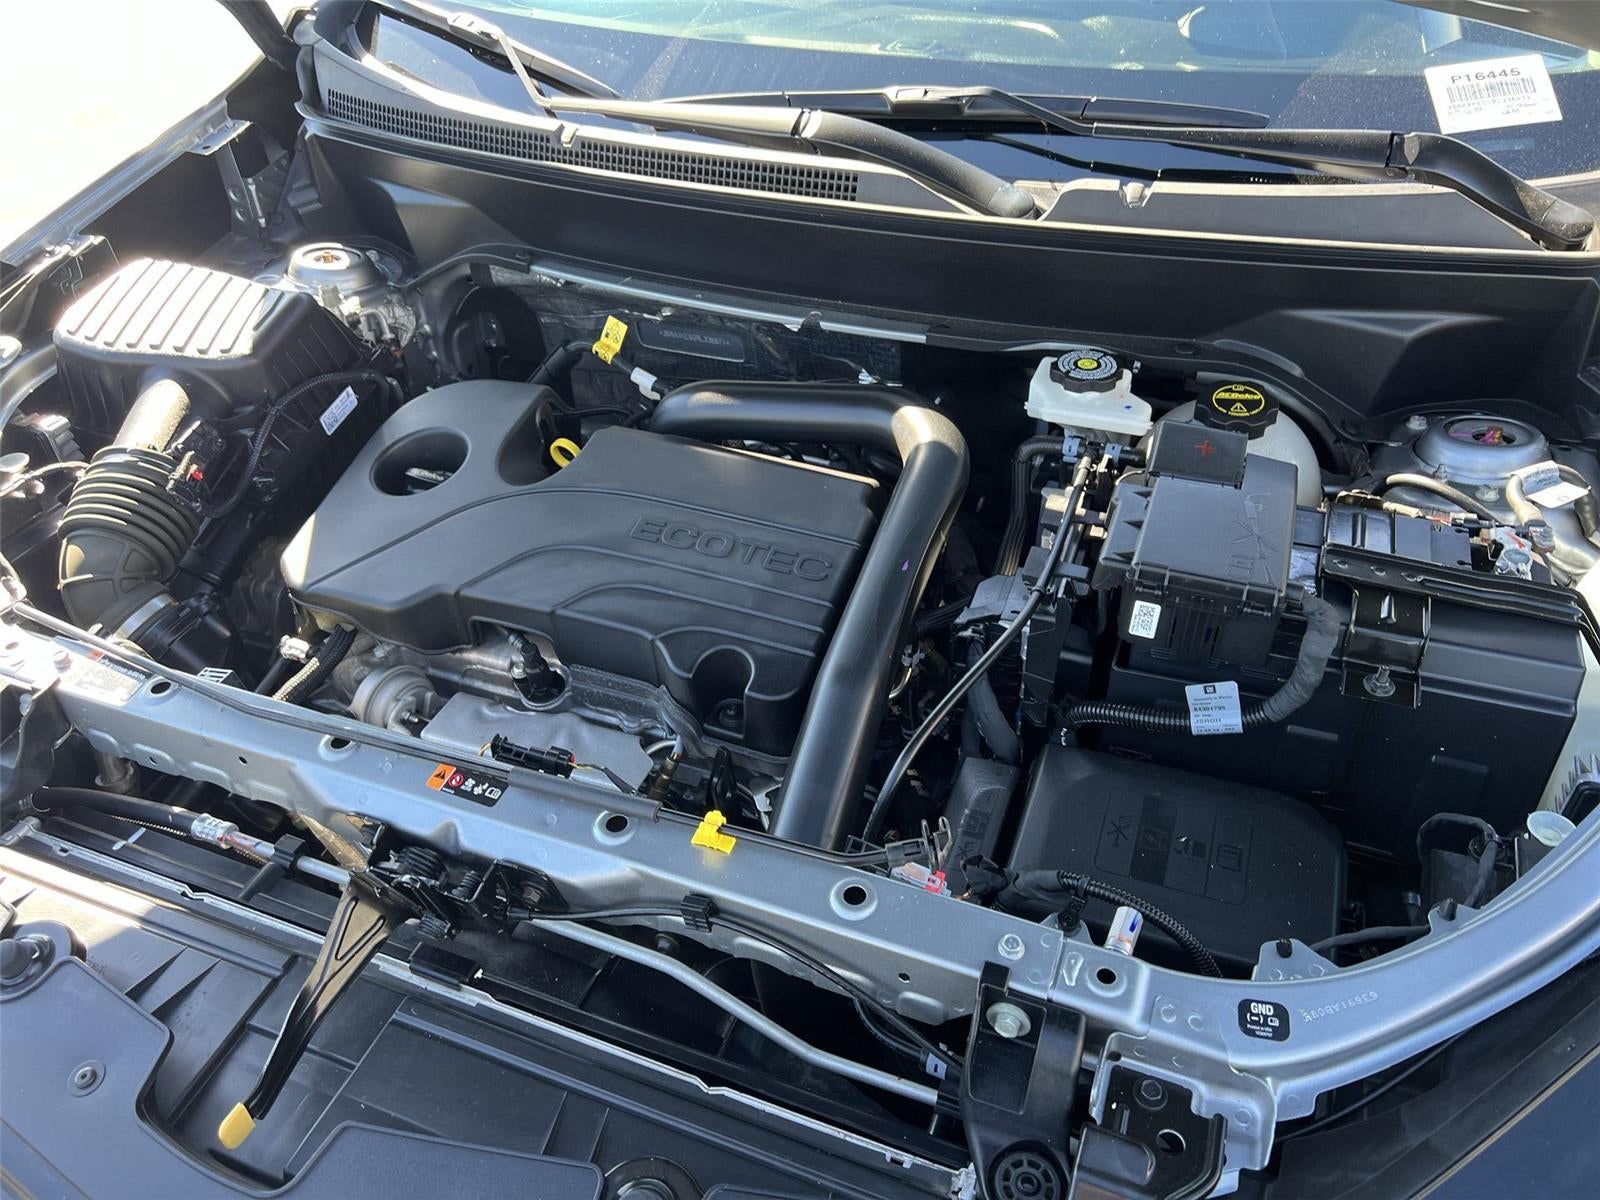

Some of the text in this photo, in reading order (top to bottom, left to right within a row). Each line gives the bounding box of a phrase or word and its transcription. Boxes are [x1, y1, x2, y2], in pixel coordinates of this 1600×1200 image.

[1450, 67, 1522, 84] P16445
[629, 515, 833, 582] ECOTEC
[1250, 1002, 1274, 1016] GND
